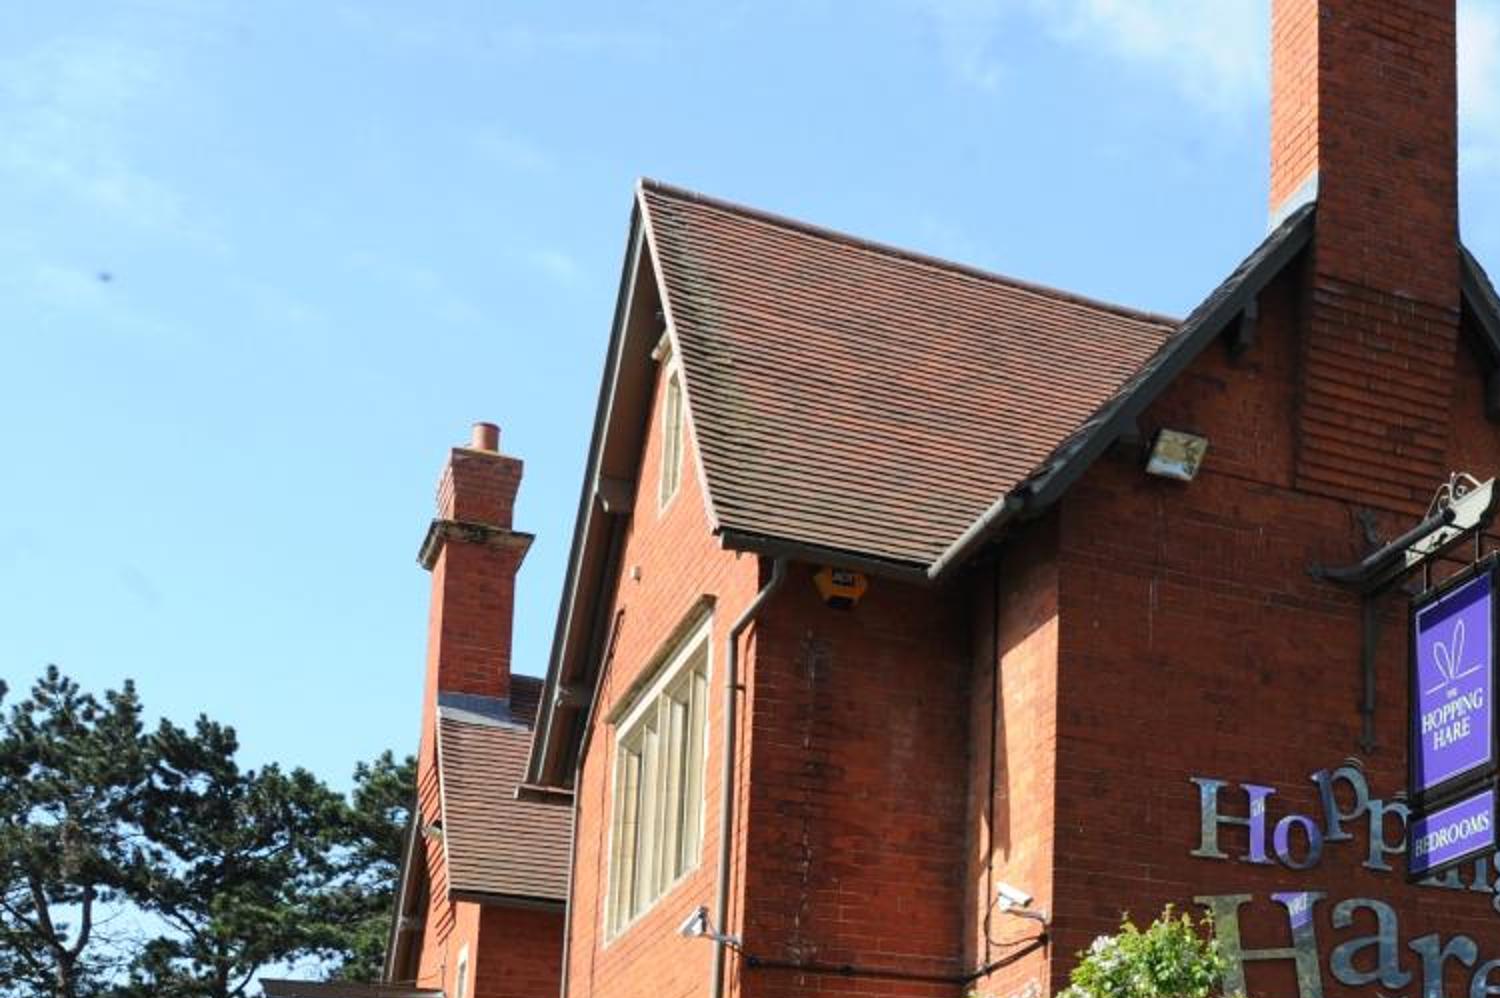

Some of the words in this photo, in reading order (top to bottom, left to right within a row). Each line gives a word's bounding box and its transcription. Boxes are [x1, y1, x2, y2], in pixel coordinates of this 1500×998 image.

[1422, 687, 1484, 736] HOPPING
[1434, 715, 1471, 751] HARE
[1415, 810, 1489, 858] BEDROOMS
